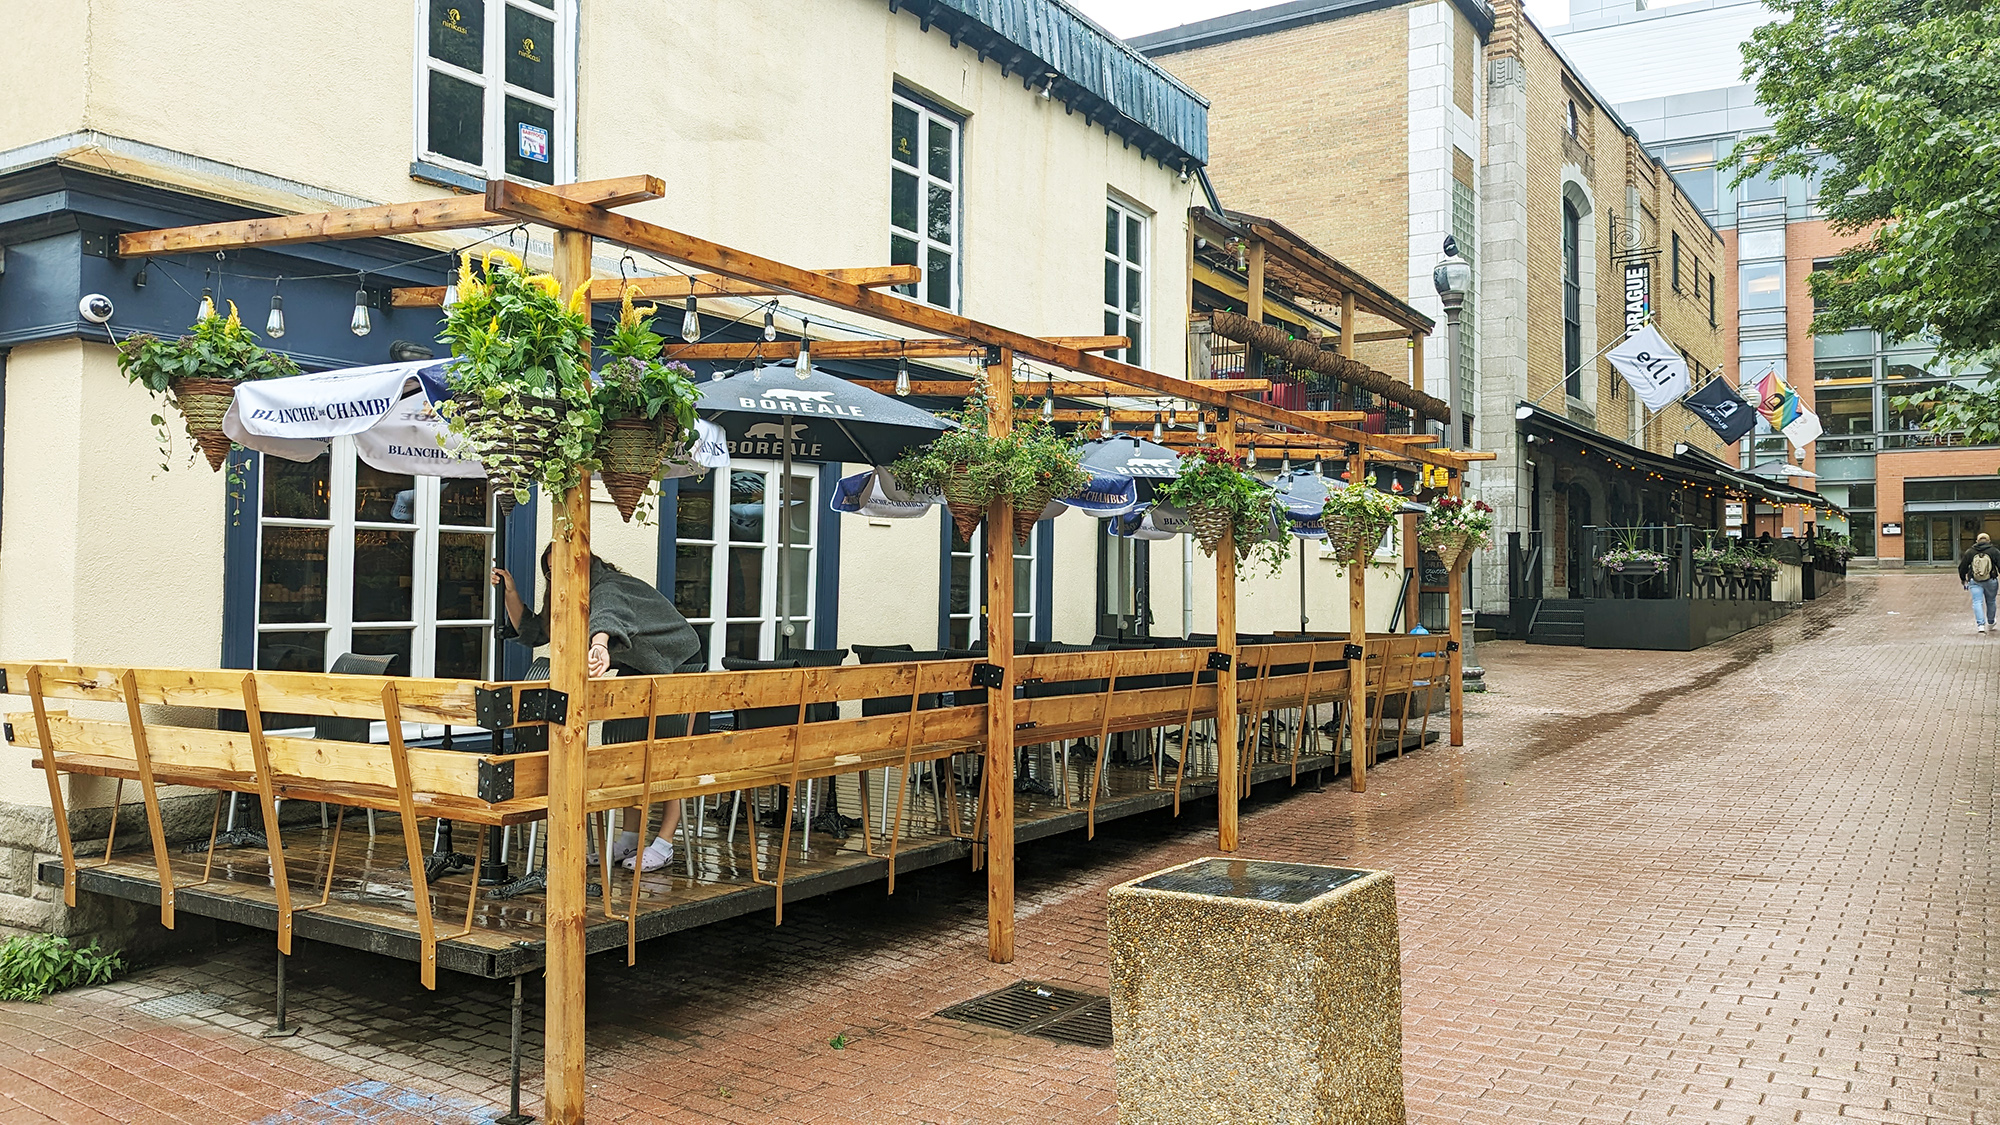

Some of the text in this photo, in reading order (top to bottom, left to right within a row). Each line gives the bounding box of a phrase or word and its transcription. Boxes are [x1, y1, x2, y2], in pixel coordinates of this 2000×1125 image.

[1626, 267, 1645, 337] DRAGUE
[1637, 351, 1676, 386] elli
[250, 406, 318, 423] BLANCHE
[1701, 404, 1729, 430] DRAGUE
[1086, 491, 1128, 504] CHAMBLY
